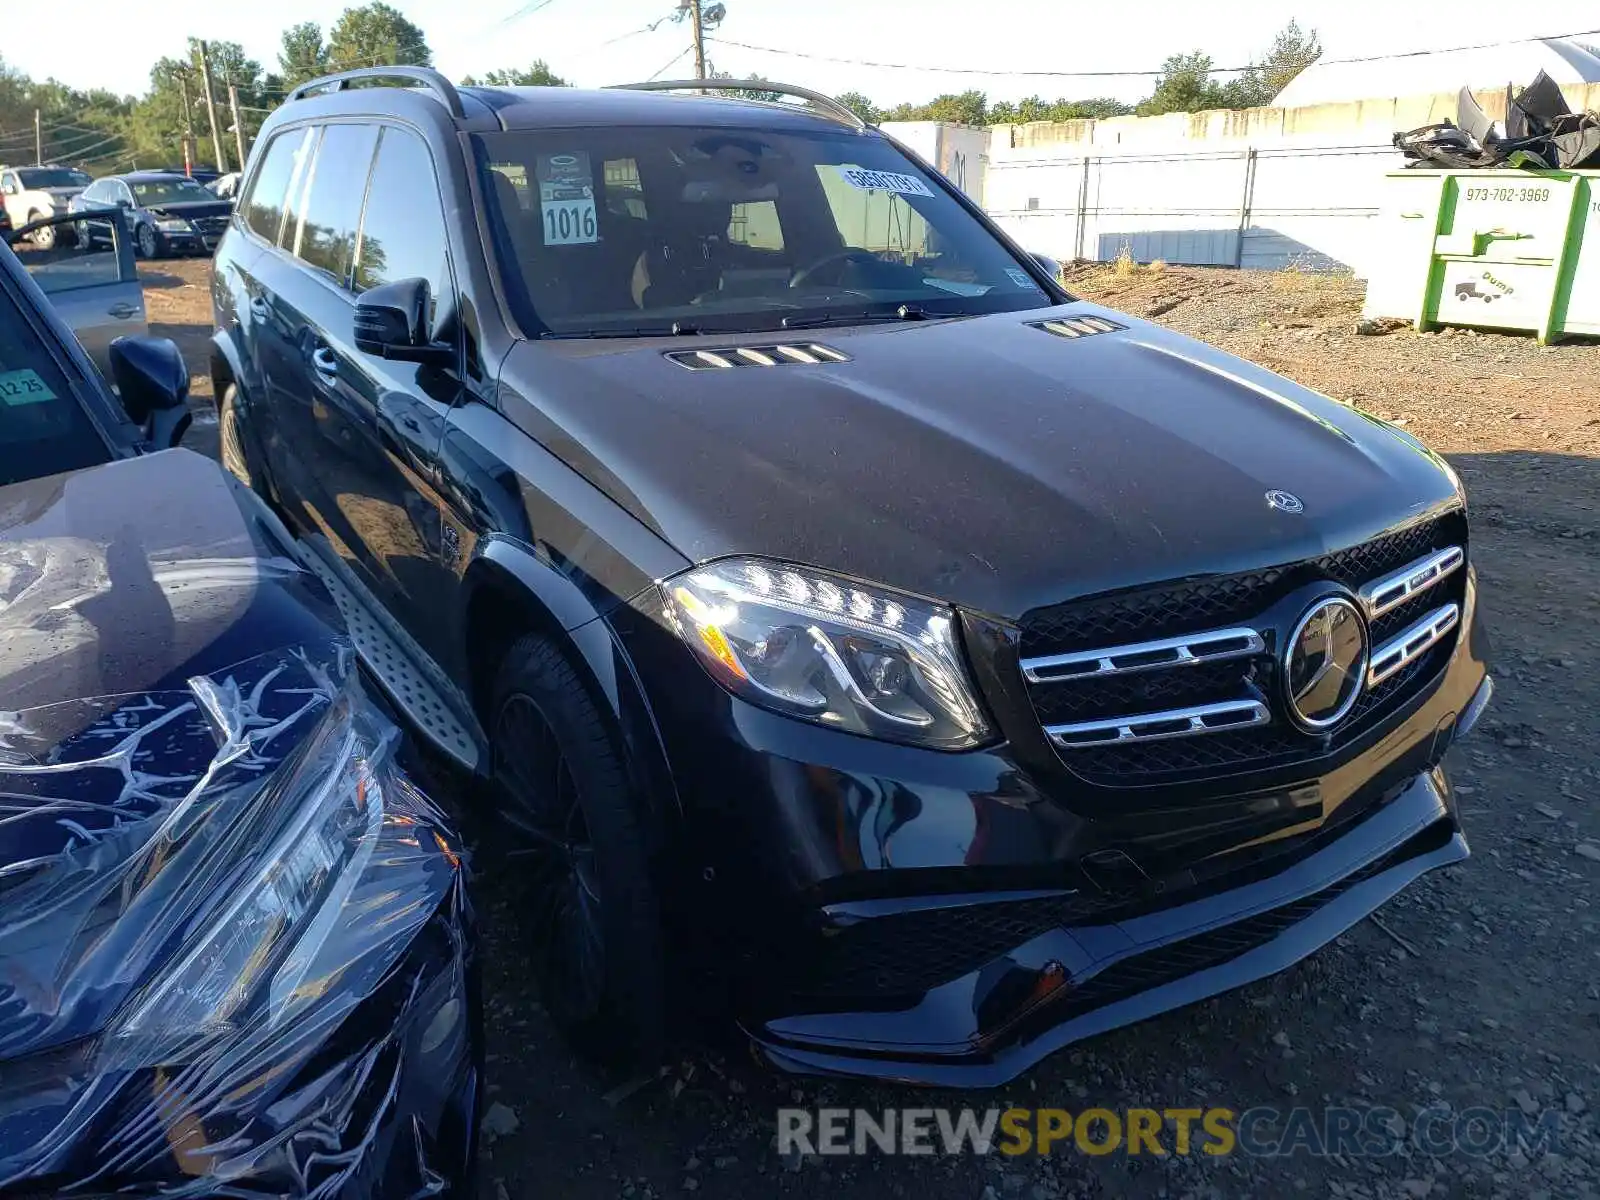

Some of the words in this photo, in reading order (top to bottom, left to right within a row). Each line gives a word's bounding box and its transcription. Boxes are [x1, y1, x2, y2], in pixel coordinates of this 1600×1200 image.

[1466, 188, 1550, 202] 973-702-3969
[546, 206, 595, 240] 1016
[1482, 271, 1514, 295] Dump
